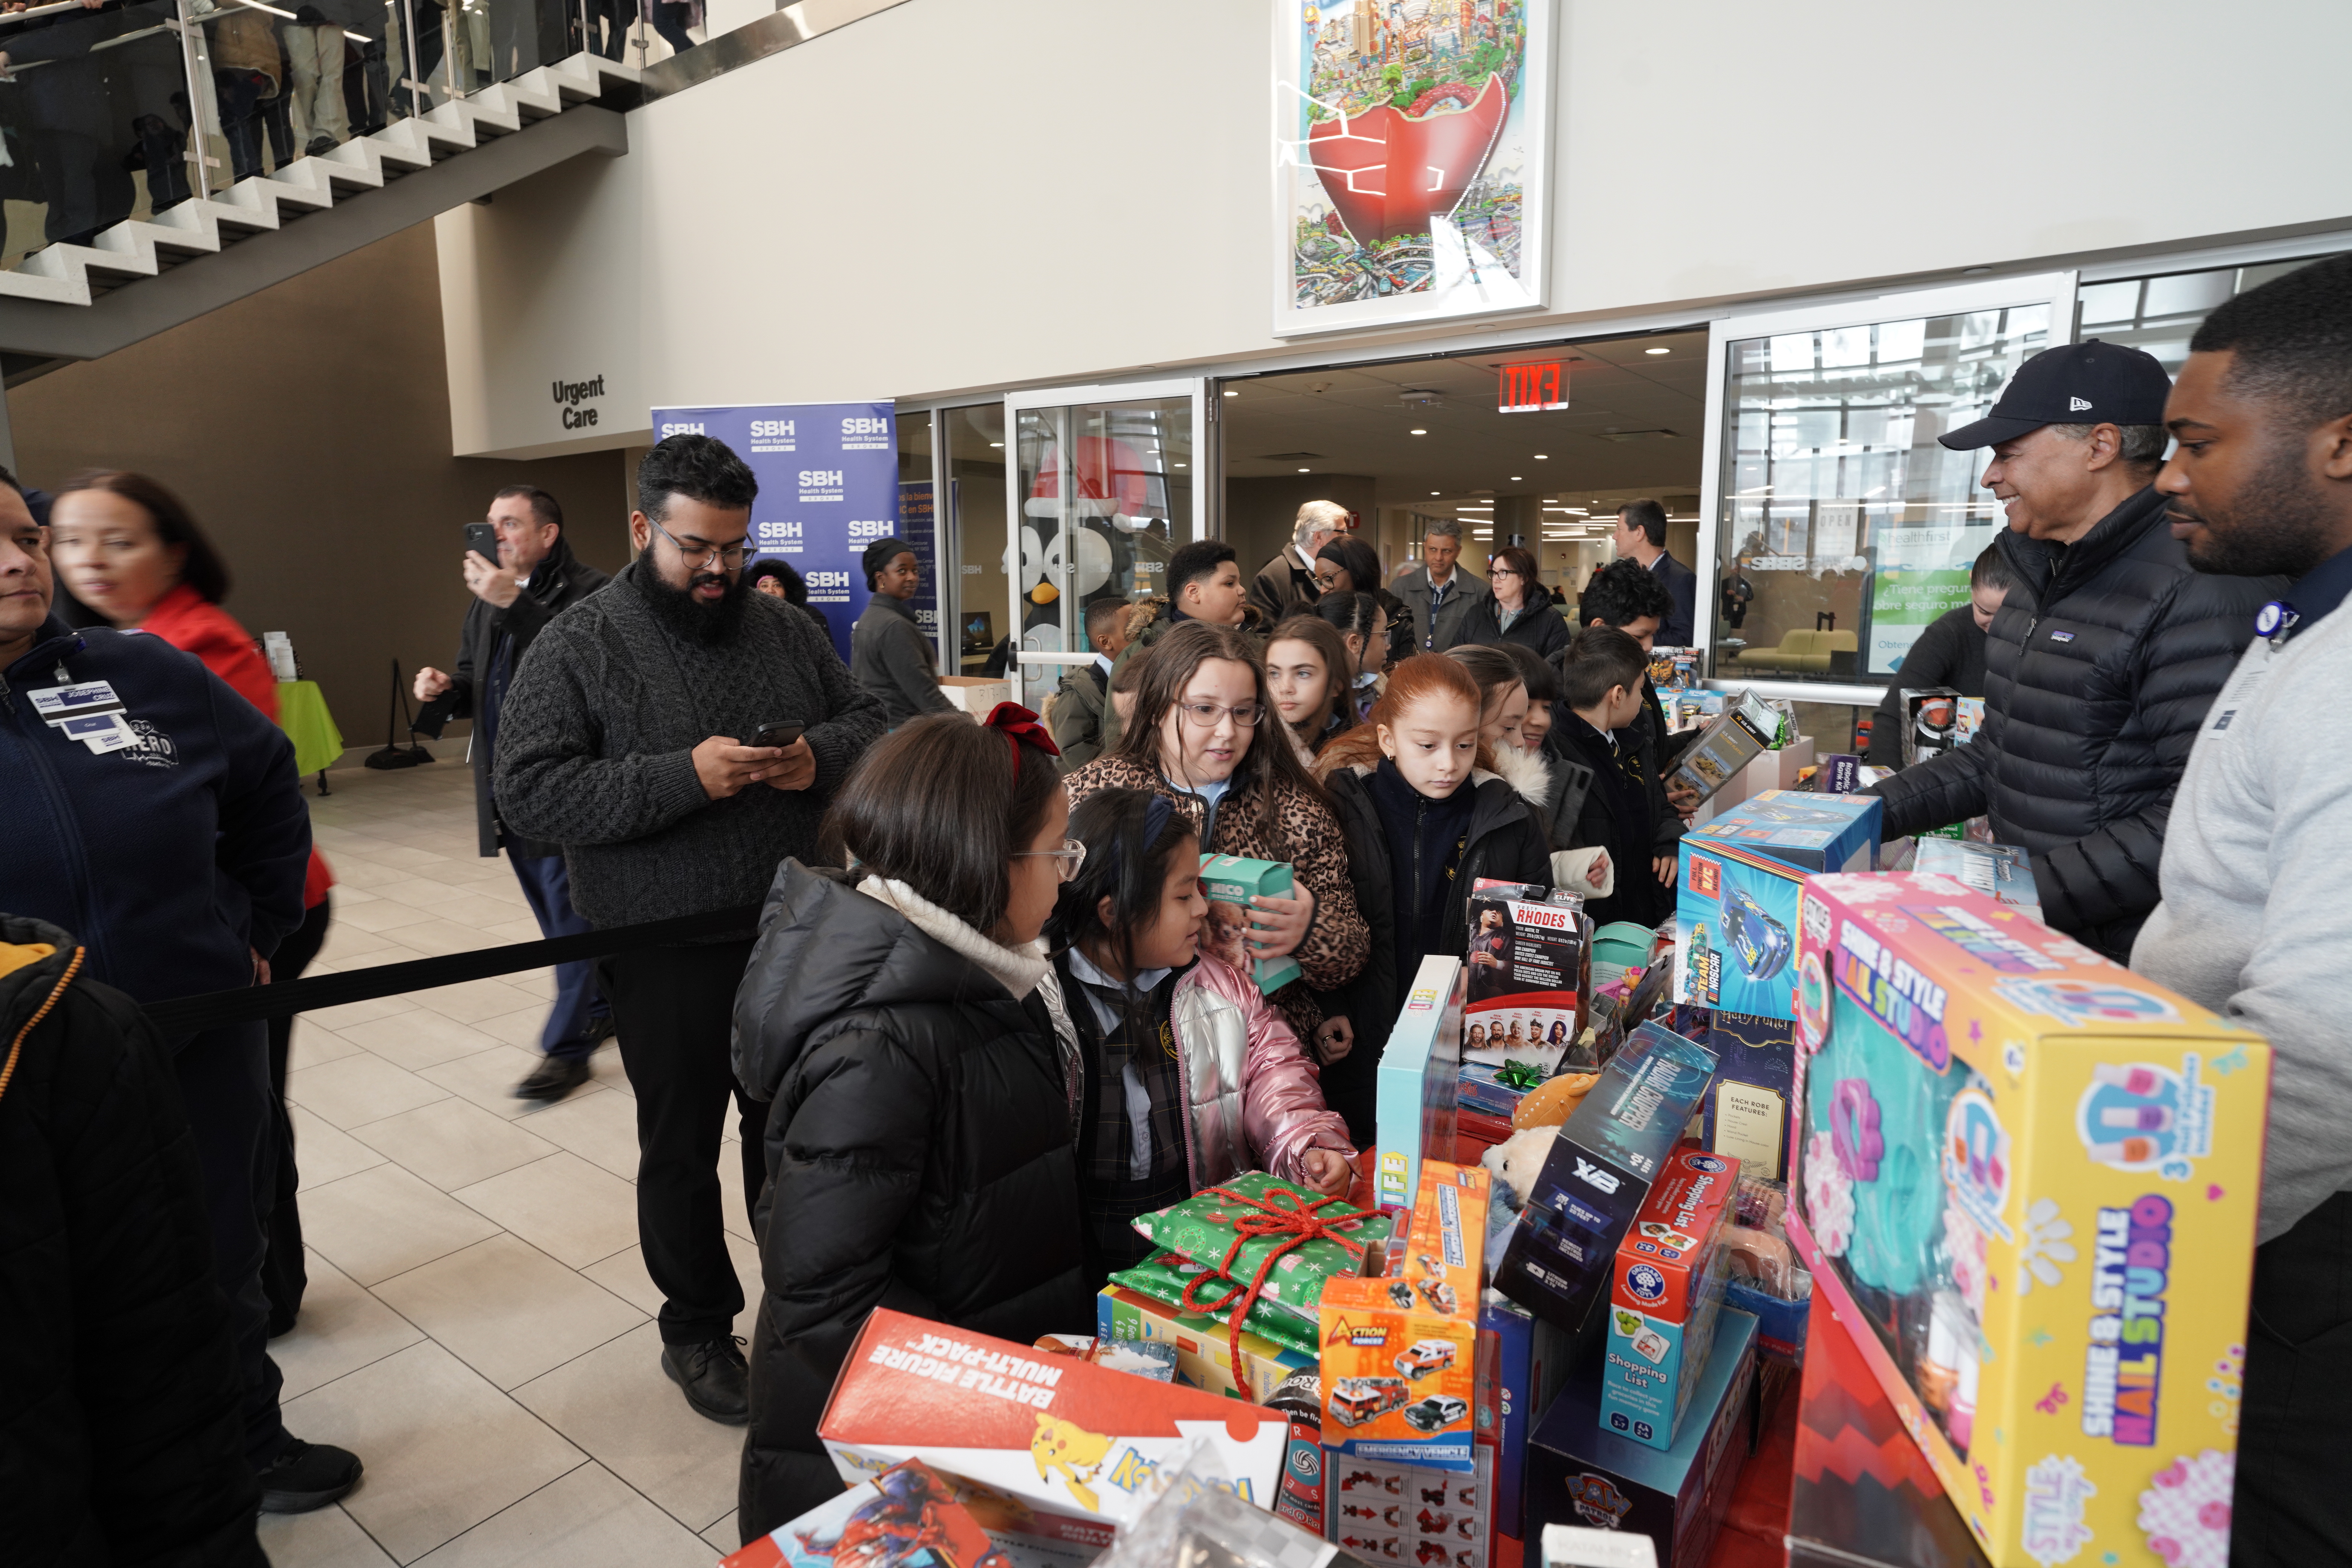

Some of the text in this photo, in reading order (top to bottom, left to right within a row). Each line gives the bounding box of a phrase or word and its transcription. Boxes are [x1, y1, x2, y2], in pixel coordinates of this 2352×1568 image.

[553, 374, 605, 405] Urgent
[562, 407, 598, 429] Care
[841, 418, 888, 434] SBH
[662, 423, 704, 438] SBH
[750, 420, 795, 437] SBH
[799, 470, 843, 487] SBH
[758, 522, 802, 538] SBH
[848, 521, 894, 536] SBH
[961, 565, 982, 574] SBH
[805, 571, 849, 587] SBH
[1905, 602, 1948, 612] seguro
[67, 686, 110, 698] JOSEPHINE
[92, 693, 115, 701] CRUZ
[1836, 761, 1845, 780] Bank
[1842, 762, 1853, 790] Robotic
[1703, 867, 1713, 890] R/C
[1517, 909, 1566, 928] RHODES
[1698, 955, 1710, 992] TEAM
[1709, 953, 1720, 991] NASCAR
[1840, 919, 1881, 971] SHINE
[1878, 947, 1893, 981] &
[1892, 957, 1948, 1023] STYLE
[1410, 991, 1435, 1009] LIFE
[1835, 943, 1872, 1005] NAIL
[1873, 977, 1949, 1068] STUDIO
[1645, 1058, 1681, 1092] RADAR
[1619, 1085, 1664, 1132] CHOPPER
[1731, 1096, 1770, 1110] EACH ROBE
[1732, 1104, 1767, 1117] FEATURES:
[1629, 1152, 1644, 1167] 10+
[1640, 1158, 1653, 1173] AGES
[1383, 1158, 1405, 1203] IFE
[1678, 1174, 1714, 1211] Shopping
[1577, 1212, 1590, 1222] FEET
[1673, 1210, 1696, 1228] List
[1560, 1242, 1582, 1257] CONTROL
[1562, 1237, 1583, 1253] REMOTE
[1558, 1246, 1583, 1262] INCLUDED
[1546, 1275, 1568, 1290] BATTERY
[1631, 1266, 1662, 1283] ORCHARD
[1621, 1284, 1641, 1305] Learning
[1636, 1288, 1654, 1298] TOYS
[1331, 1318, 1387, 1338] ACTION
[2082, 1207, 2131, 1438] SHINE & STYLE
[2112, 1193, 2173, 1446] NAIL STUDIO
[1772, 1343, 1793, 1355] PACK
[1608, 1352, 1668, 1383] Shopping
[868, 1344, 1056, 1410] BATTLE FIGURE
[1625, 1372, 1648, 1389] List
[1608, 1380, 1621, 1389] Race
[1629, 1389, 1648, 1399] collect
[1612, 1389, 1638, 1402] groceries
[1299, 1409, 1308, 1418] be
[1619, 1398, 1642, 1410] memory
[1643, 1407, 1660, 1416] game
[1614, 1419, 1625, 1428] 3-7
[1358, 1445, 1420, 1458] EMERGENCY
[1290, 1496, 1303, 1506] most
[1565, 1475, 1633, 1517] PAW
[1580, 1504, 1614, 1524] PATROL
